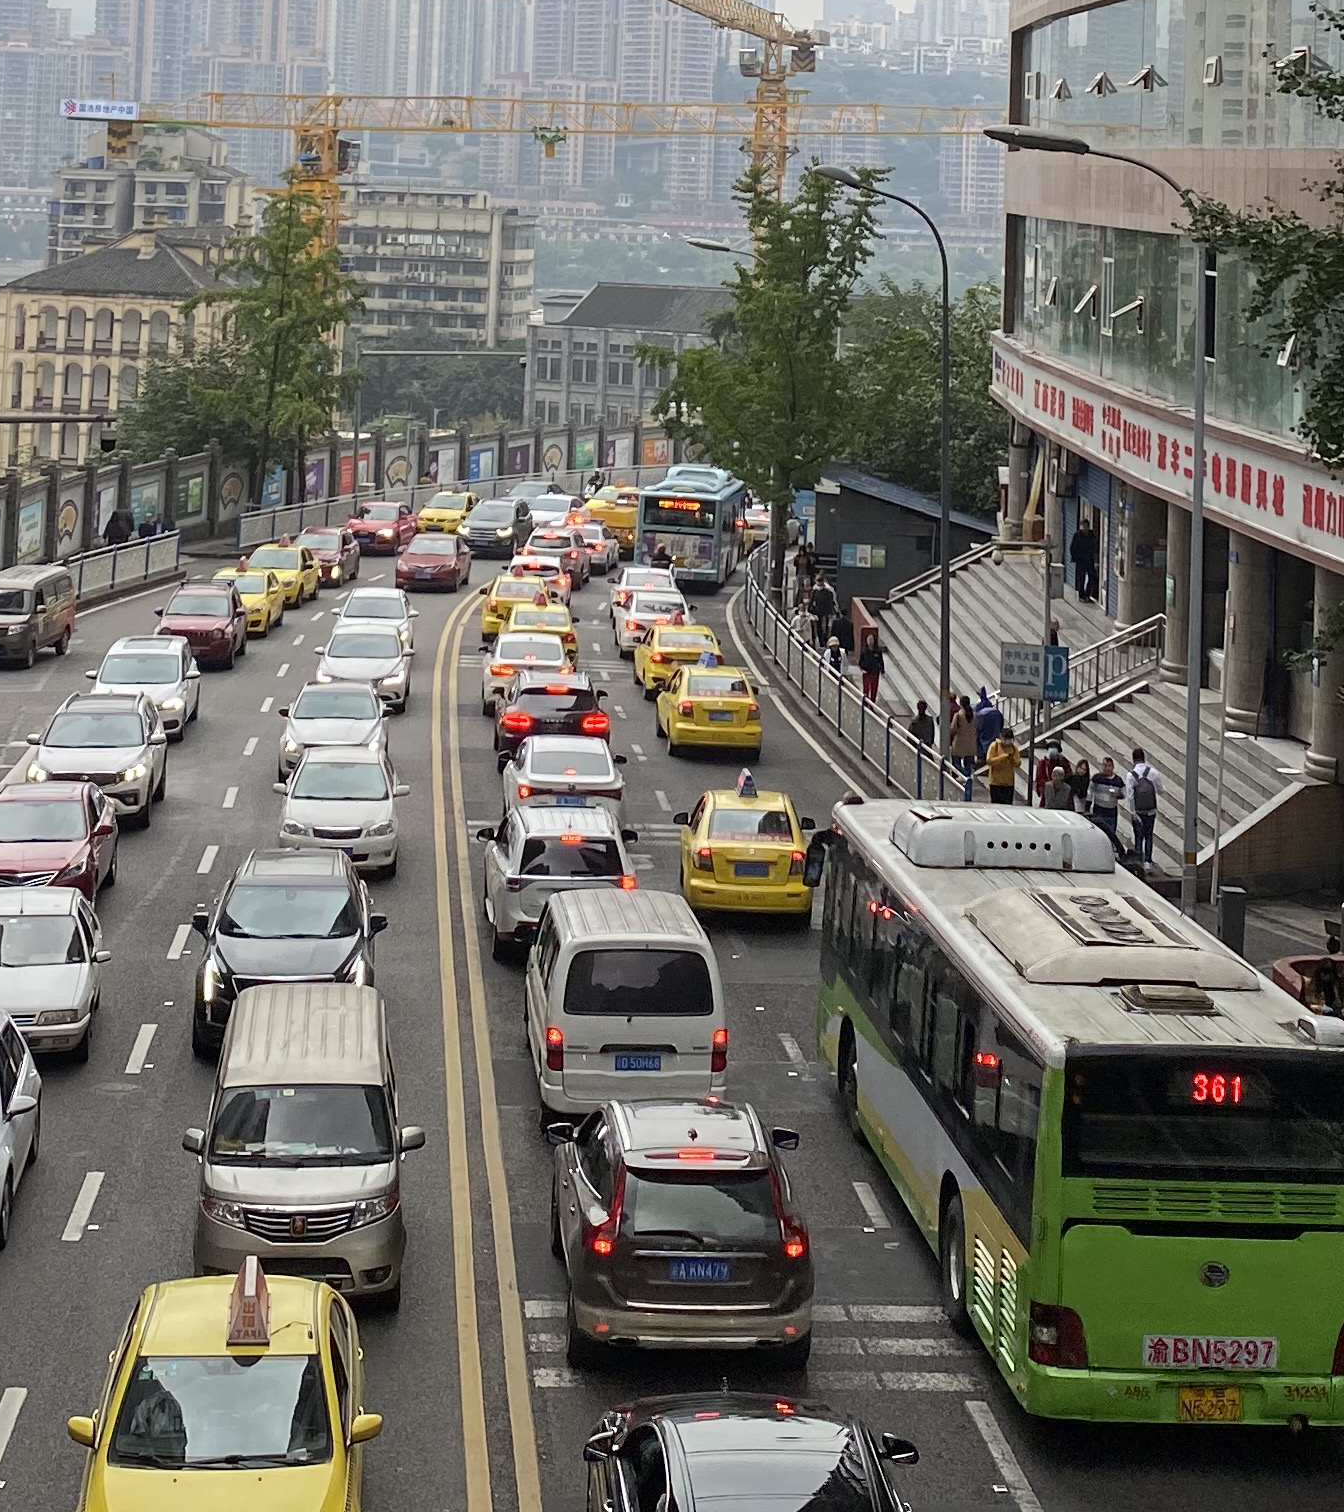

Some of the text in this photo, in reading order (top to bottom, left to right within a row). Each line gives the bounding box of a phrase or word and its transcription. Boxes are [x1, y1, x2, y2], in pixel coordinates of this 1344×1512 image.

[1004, 663, 1041, 678] 停车场
[1191, 1073, 1243, 1104] 361
[235, 1329, 261, 1338] TAXI
[1147, 1337, 1274, 1368] 渝BN5297
